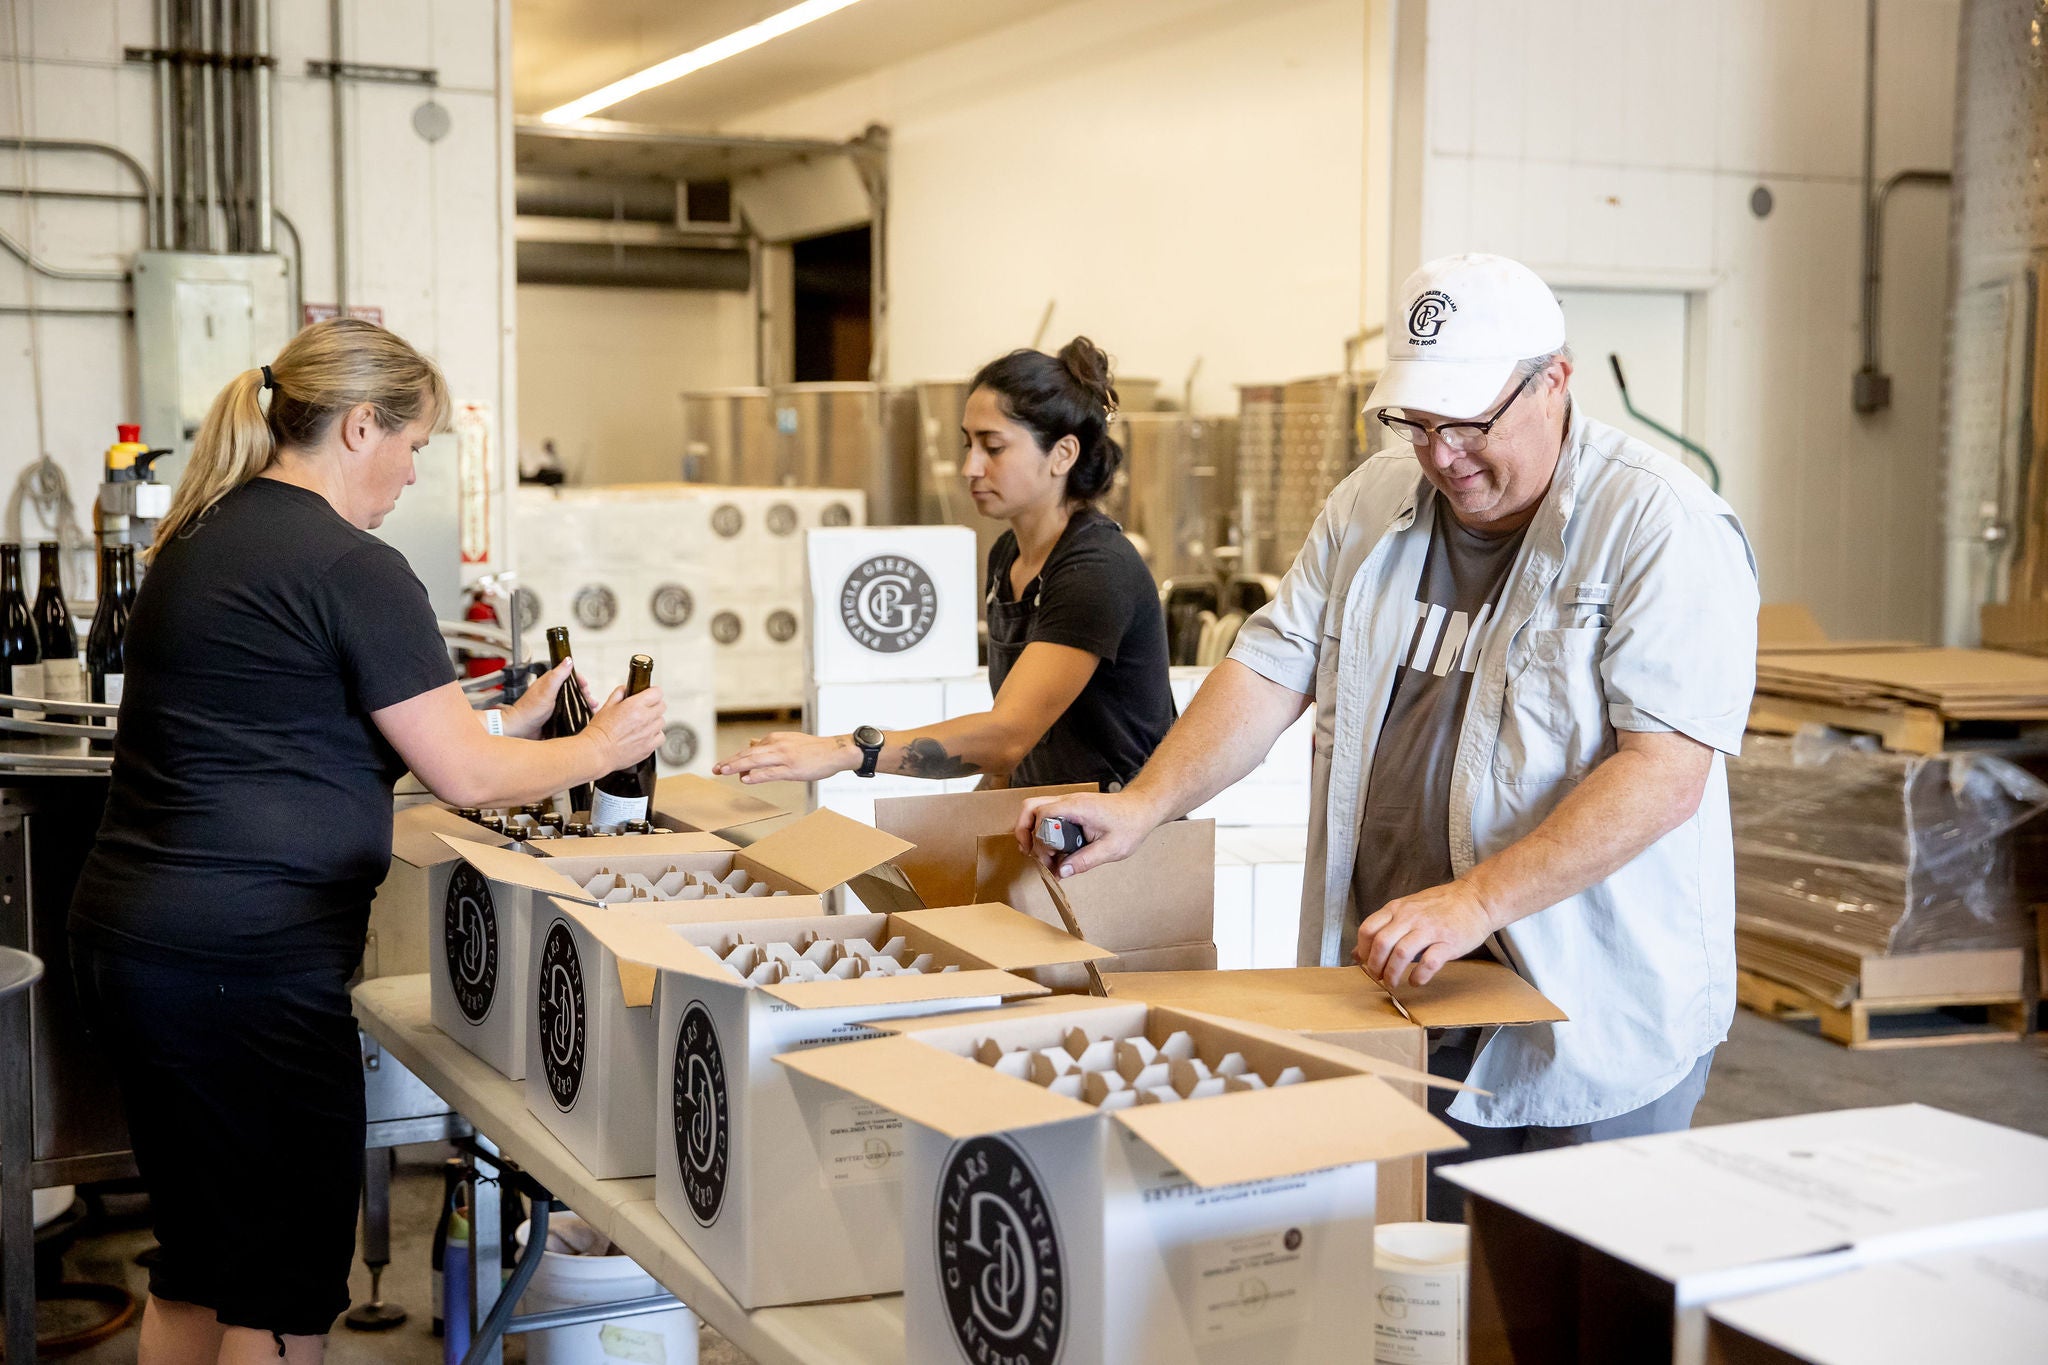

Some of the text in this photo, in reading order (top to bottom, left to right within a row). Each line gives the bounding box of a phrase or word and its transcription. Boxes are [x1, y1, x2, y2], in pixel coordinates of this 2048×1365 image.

[843, 579, 882, 649] PATRICIA
[862, 558, 919, 579] GREEN
[896, 583, 935, 649] CELLARS
[448, 874, 497, 1011] PATRICIA GREEN CELLARS
[541, 935, 583, 1096] PATRICIA GREEN CELLARS
[675, 1019, 726, 1208] PATRICIA GREEN CELLARS
[944, 1149, 990, 1290] CELLARS
[1008, 1165, 1058, 1350] PATRICIA
